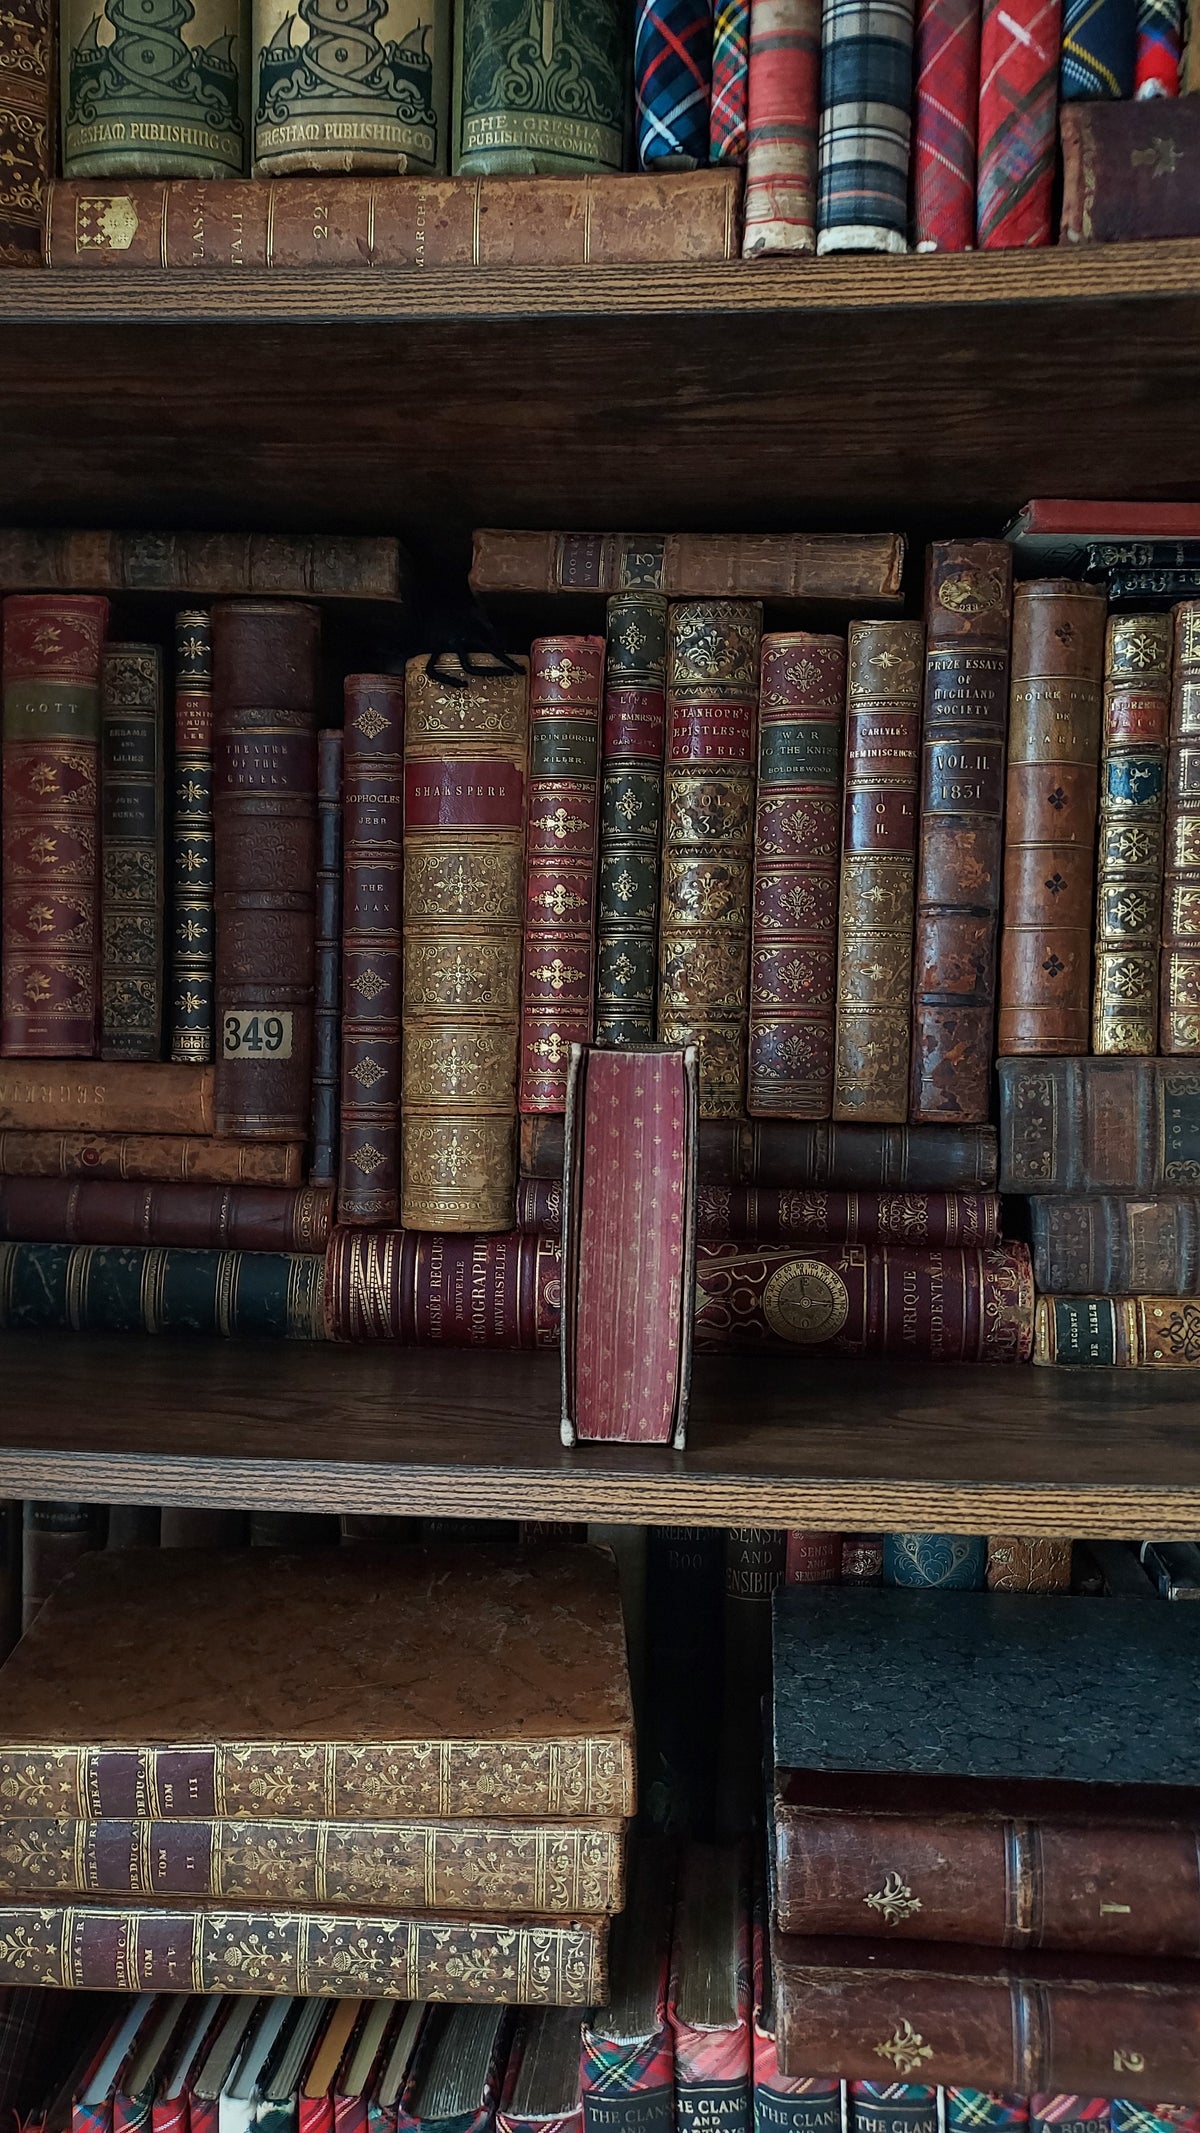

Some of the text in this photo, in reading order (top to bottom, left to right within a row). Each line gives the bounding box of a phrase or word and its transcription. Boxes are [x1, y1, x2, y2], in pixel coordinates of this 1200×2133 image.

[467, 115, 507, 134] THE
[130, 122, 219, 149] PUBLISHING
[324, 123, 412, 144] PUBLISHING
[414, 131, 432, 150] CO
[635, 553, 655, 567] 3
[928, 659, 1004, 671] PRIZE ESSAYS
[957, 675, 973, 684] OF
[934, 688, 996, 700] HIGHLAND
[16, 702, 79, 714] COTT
[674, 707, 750, 721] STANHOPE'S
[936, 705, 991, 716] SOCIETY
[183, 732, 205, 740] LEE
[781, 731, 820, 740] WAR
[861, 723, 908, 737] CARLYLE'S
[226, 744, 288, 755] THEATRE
[673, 745, 745, 757] GOSPELS
[780, 746, 801, 755] THE
[254, 759, 280, 769] THE
[767, 766, 832, 774] BOLDREWOOD
[227, 774, 288, 785] GREEKS
[414, 786, 506, 797] SHAKSPERE
[941, 784, 981, 800] 1831
[346, 794, 401, 804] SOPHOCLES
[361, 883, 385, 892] THE
[353, 903, 392, 913] AJAX
[224, 1016, 284, 1052] 349
[429, 1236, 445, 1289] RECLUS
[454, 1260, 465, 1321] NOUVELLE
[493, 1243, 507, 1336] UNIVERSELLE
[903, 1270, 919, 1345] AFRIQUE
[1089, 1303, 1099, 1357] DE LISLE
[739, 1550, 773, 1564] AND
[164, 1783, 174, 1808] TOM
[188, 1778, 198, 1799] III
[158, 1848, 168, 1878] TOM
[186, 1856, 195, 1870] II
[144, 1948, 154, 1978] TOM
[1113, 2049, 1145, 2072] 2
[702, 2096, 748, 2115] CLANS
[589, 2106, 621, 2125] THE
[758, 2101, 789, 2126] THE
[691, 2116, 721, 2127] AND
[855, 2114, 887, 2132] THE
